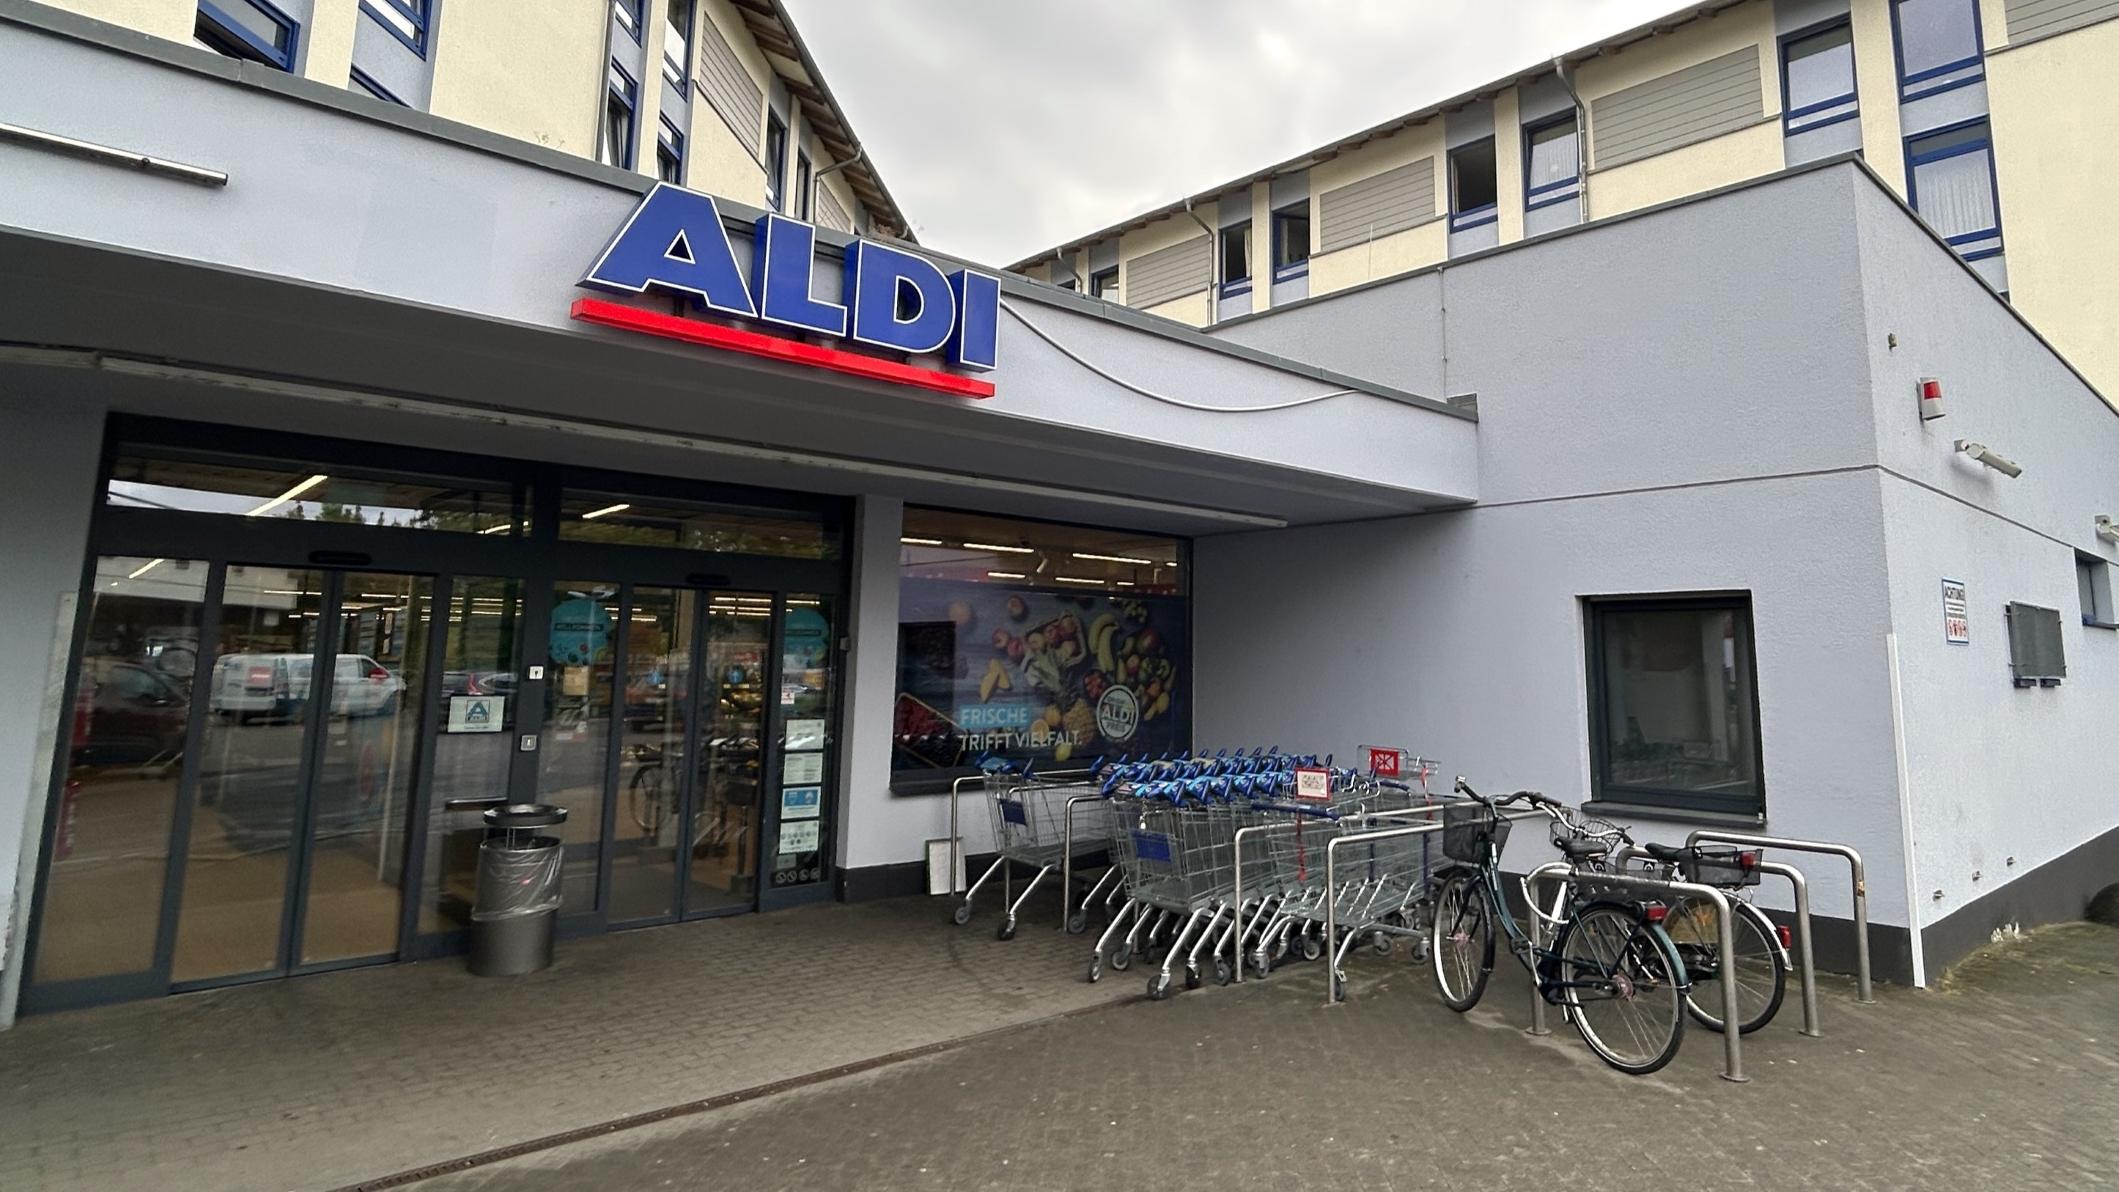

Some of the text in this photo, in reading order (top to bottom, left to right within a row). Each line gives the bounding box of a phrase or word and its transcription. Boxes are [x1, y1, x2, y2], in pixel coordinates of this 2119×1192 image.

[576, 181, 1000, 373] ALDI
[960, 708, 1029, 725] FRISCHE
[1101, 703, 1134, 725] ALDI
[958, 730, 1082, 751] TRIFFT VIELFALT.
